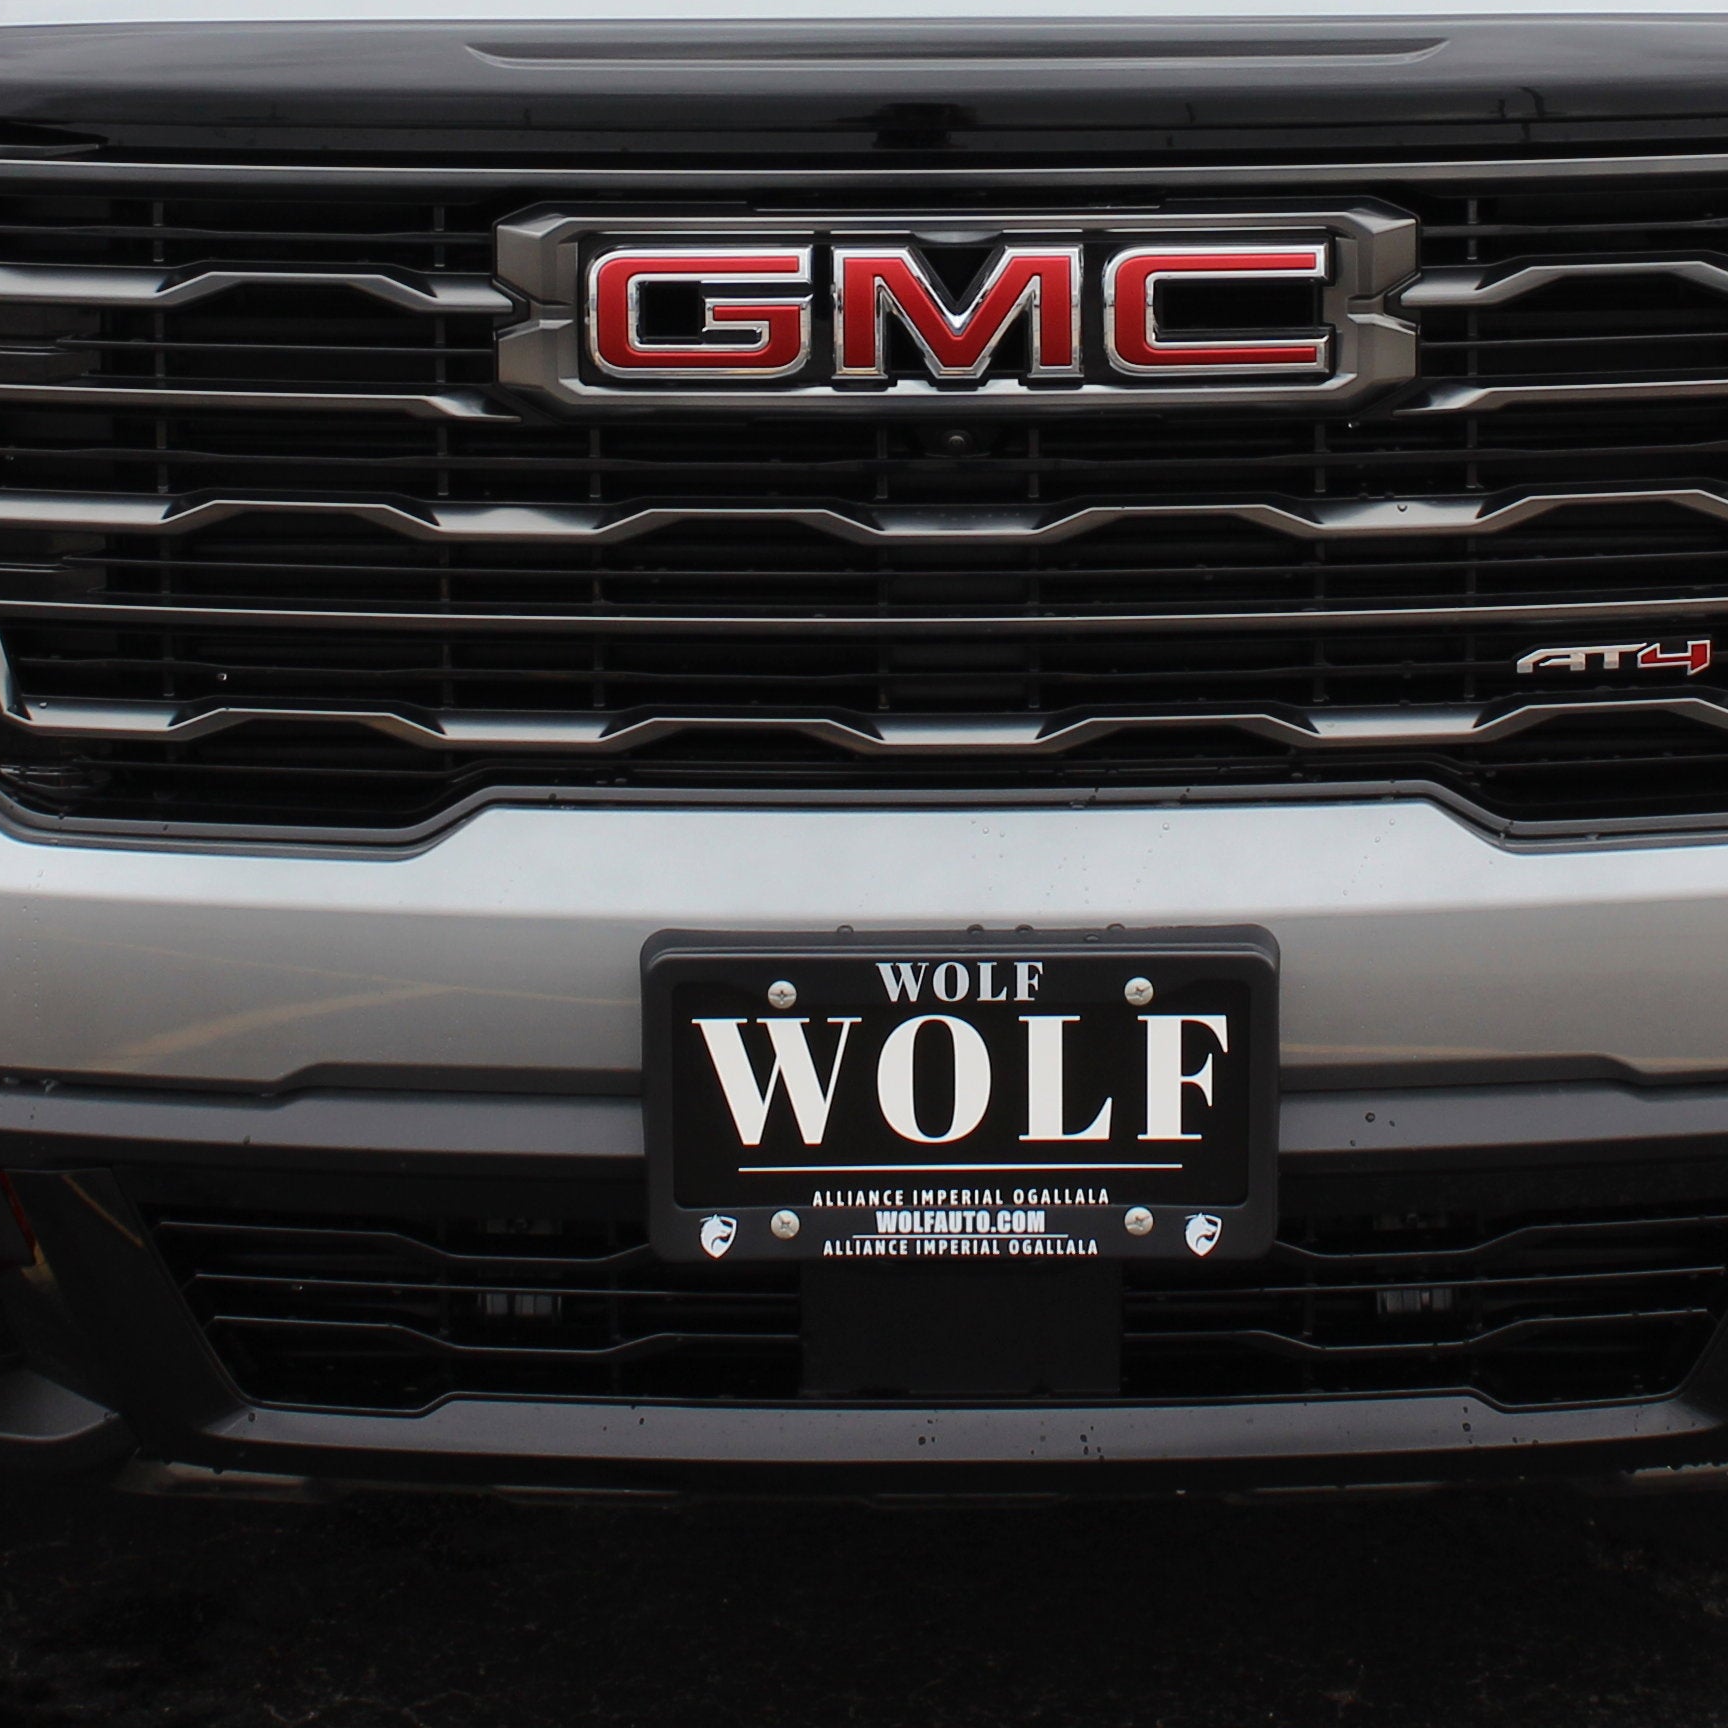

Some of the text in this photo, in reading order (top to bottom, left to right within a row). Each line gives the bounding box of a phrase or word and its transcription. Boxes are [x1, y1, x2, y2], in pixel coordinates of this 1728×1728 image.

[586, 244, 1330, 380] GMC
[1516, 639, 1710, 676] AT4
[875, 961, 1044, 1003] WOLF
[692, 1014, 1229, 1146] WOLF
[812, 1188, 1110, 1207] ALLIANCE IMPERIAL OGALLALA
[875, 1209, 1046, 1234] WOLFAUTO.COM
[823, 1238, 1098, 1256] ALLIANCE IMPERIAL OGALLALA
